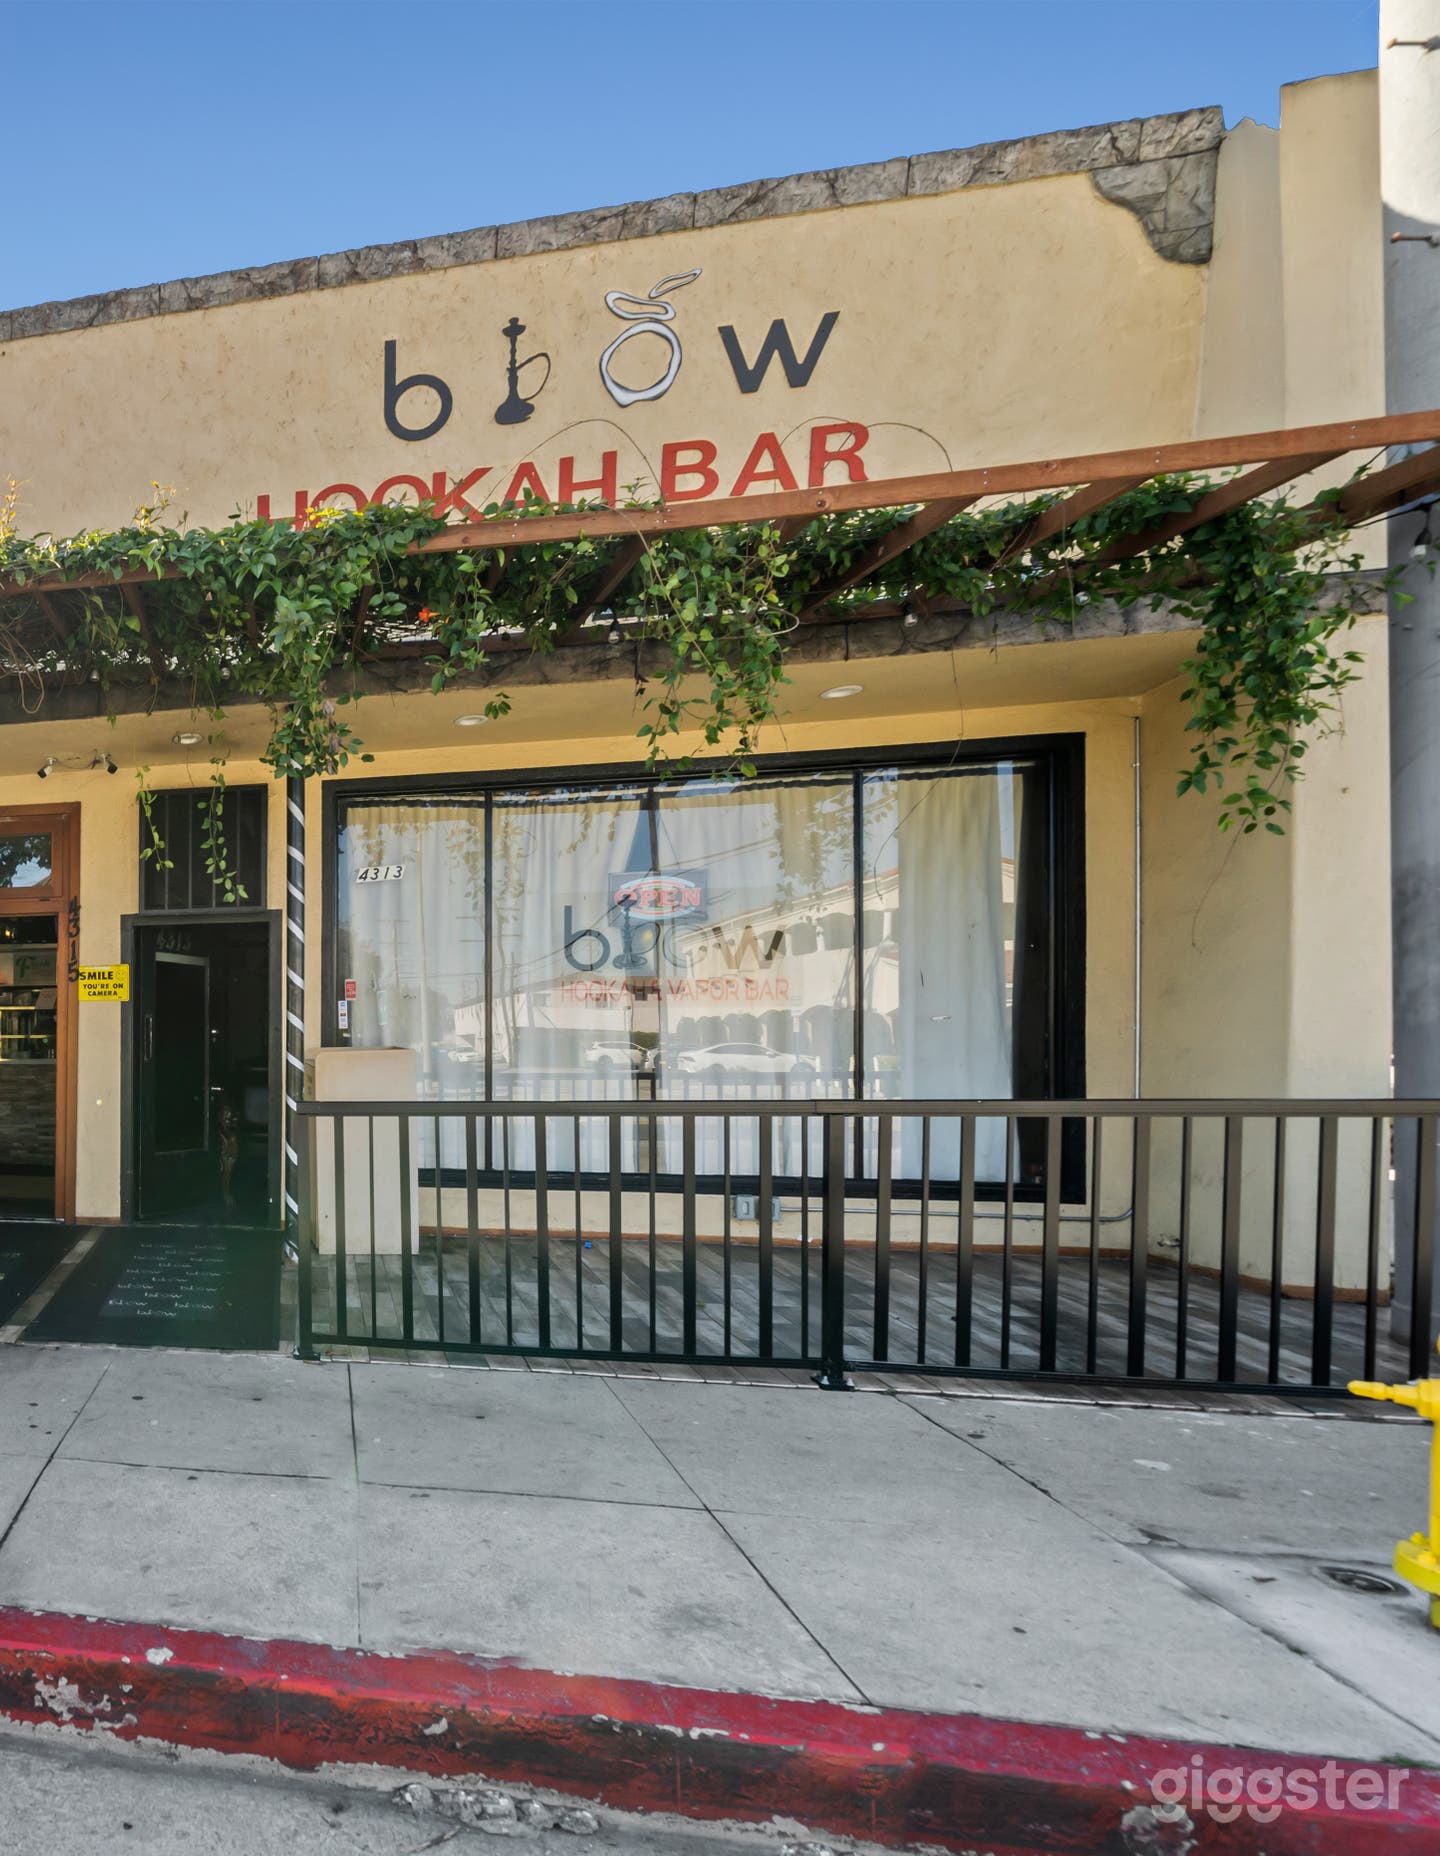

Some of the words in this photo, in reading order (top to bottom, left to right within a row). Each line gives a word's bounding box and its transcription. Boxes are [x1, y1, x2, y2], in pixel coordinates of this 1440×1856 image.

[661, 422, 869, 502] BAR
[358, 865, 404, 882] 4313
[614, 886, 701, 907] OPEN
[68, 896, 81, 982] 4315
[79, 971, 114, 981] SMILE
[561, 979, 650, 1002] HOOKAH
[667, 979, 739, 1002] VAPOR
[745, 977, 790, 1002] BAR
